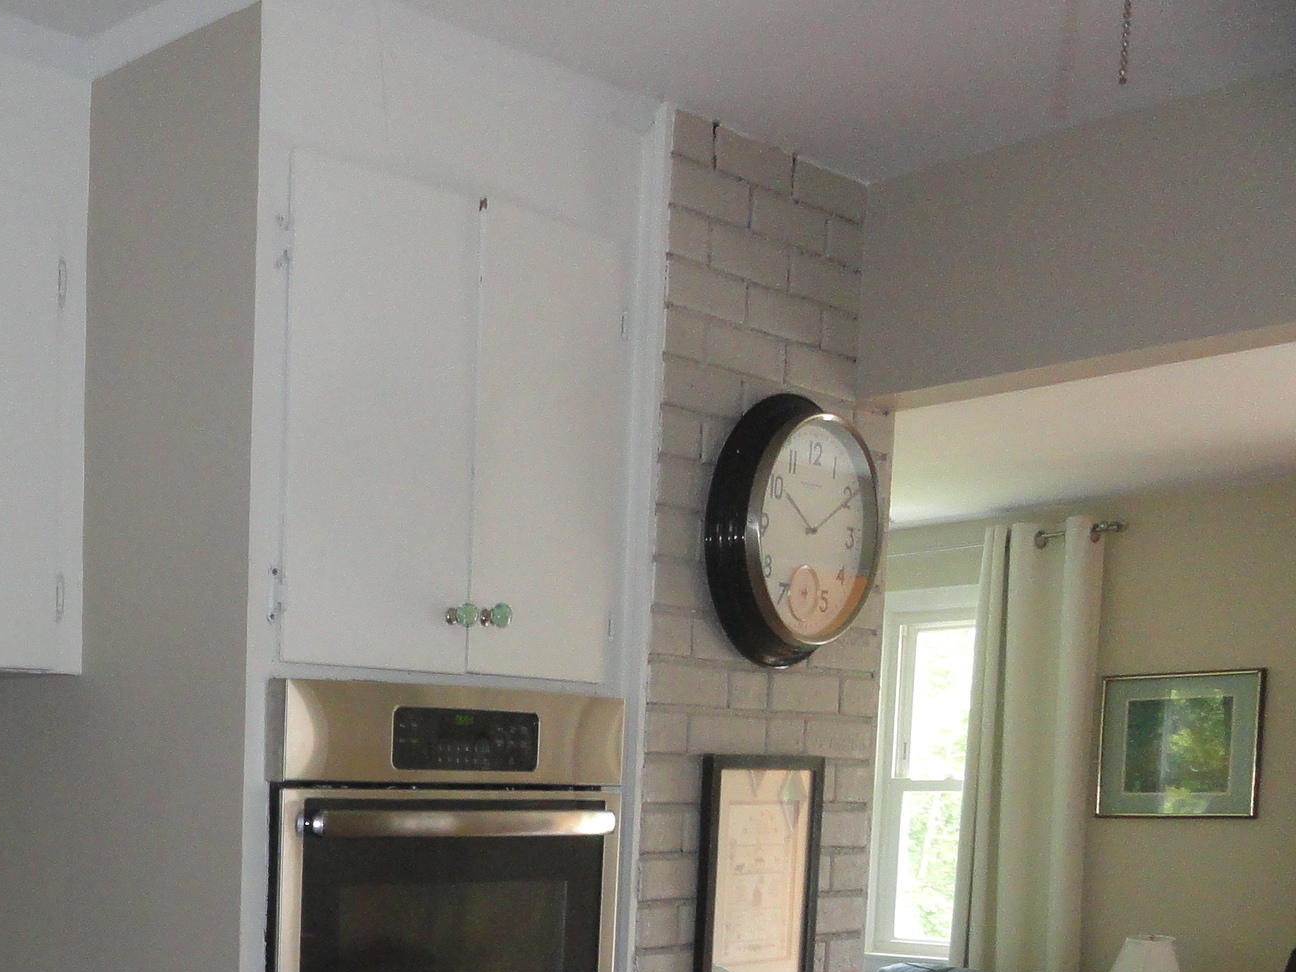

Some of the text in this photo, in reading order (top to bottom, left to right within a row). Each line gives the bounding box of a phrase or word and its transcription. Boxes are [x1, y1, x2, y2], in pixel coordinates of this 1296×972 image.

[788, 449, 798, 474] 11
[808, 440, 823, 466] 12
[832, 456, 837, 480] 1
[769, 474, 784, 499] 10
[842, 486, 853, 509] 2
[845, 527, 855, 550] 3
[764, 554, 773, 579] 8
[835, 565, 845, 585] 4
[777, 582, 790, 606] 7
[818, 590, 829, 613] 5
